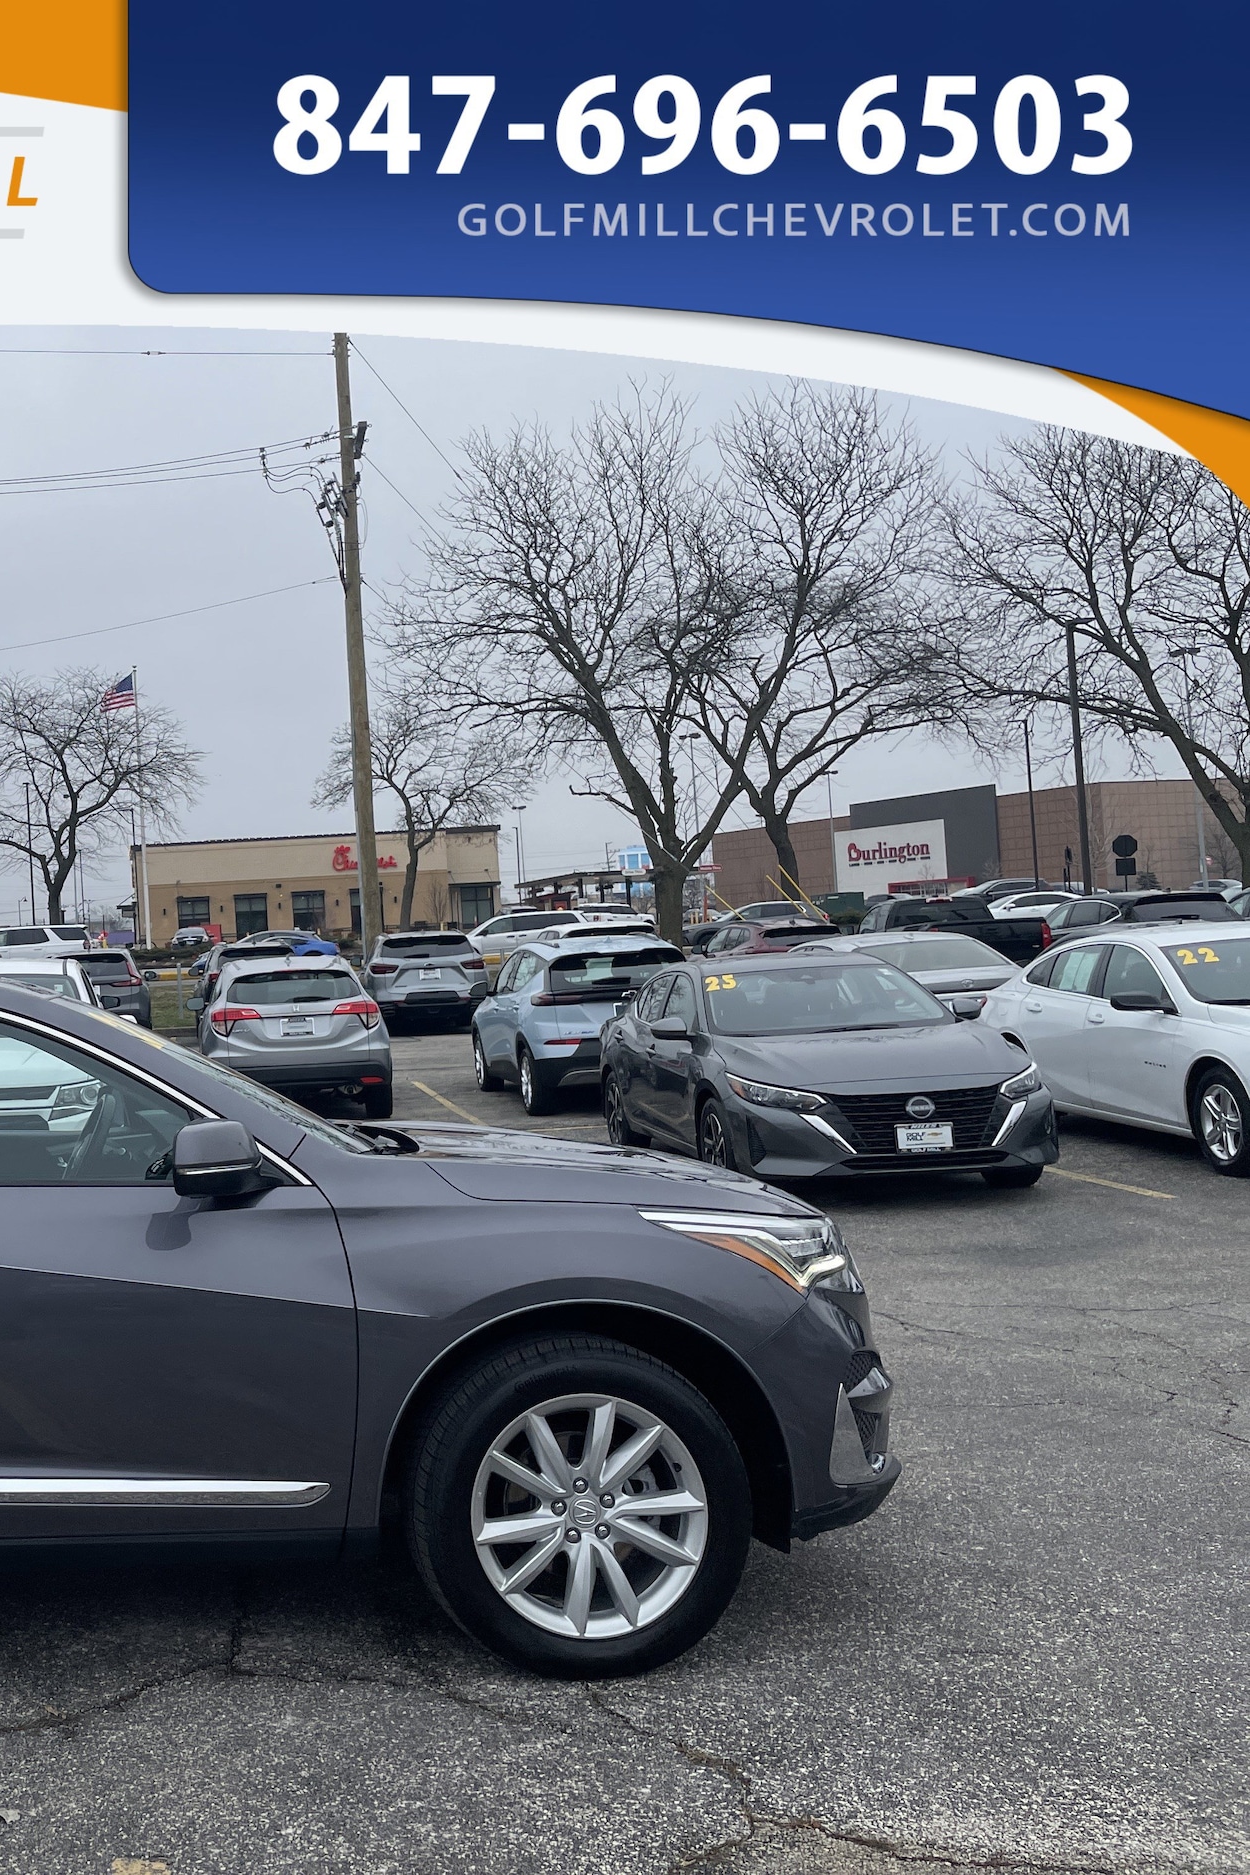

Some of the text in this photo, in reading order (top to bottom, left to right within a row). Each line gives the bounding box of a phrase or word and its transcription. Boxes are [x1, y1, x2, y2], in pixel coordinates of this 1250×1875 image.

[847, 842, 931, 864] Burlington
[1176, 947, 1220, 965] 22
[705, 974, 737, 992] 25
